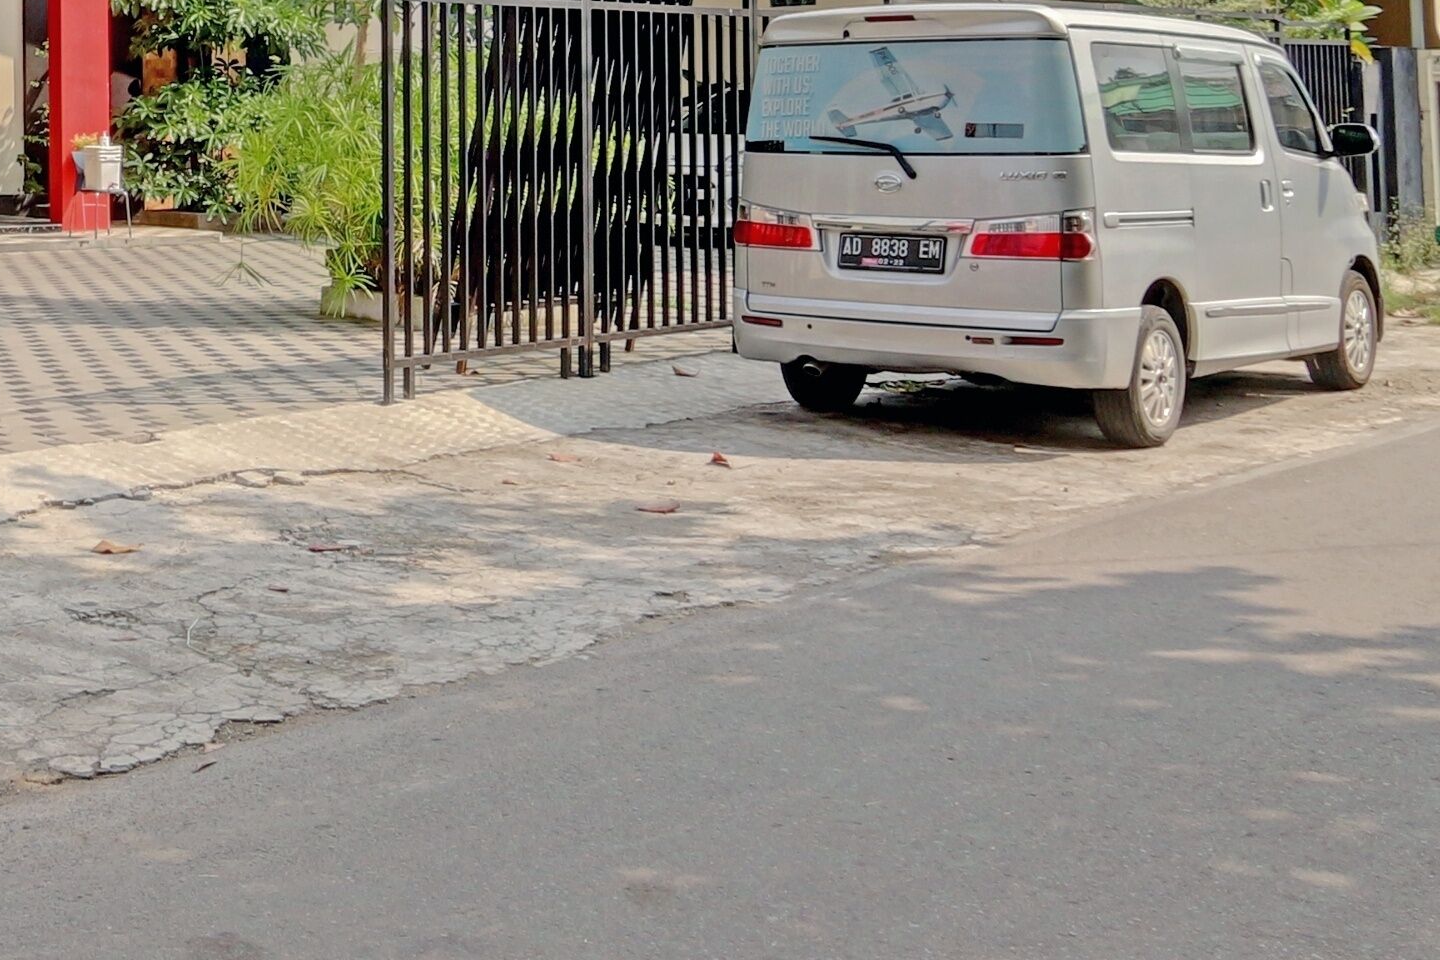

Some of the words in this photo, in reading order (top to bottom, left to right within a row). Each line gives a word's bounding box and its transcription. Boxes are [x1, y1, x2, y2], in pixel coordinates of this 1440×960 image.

[765, 55, 821, 75] TOGETHER
[761, 98, 810, 118] EXPLORE
[761, 120, 781, 138] THE
[842, 237, 861, 255] AD
[871, 238, 909, 257] 8838
[918, 240, 941, 259] EM
